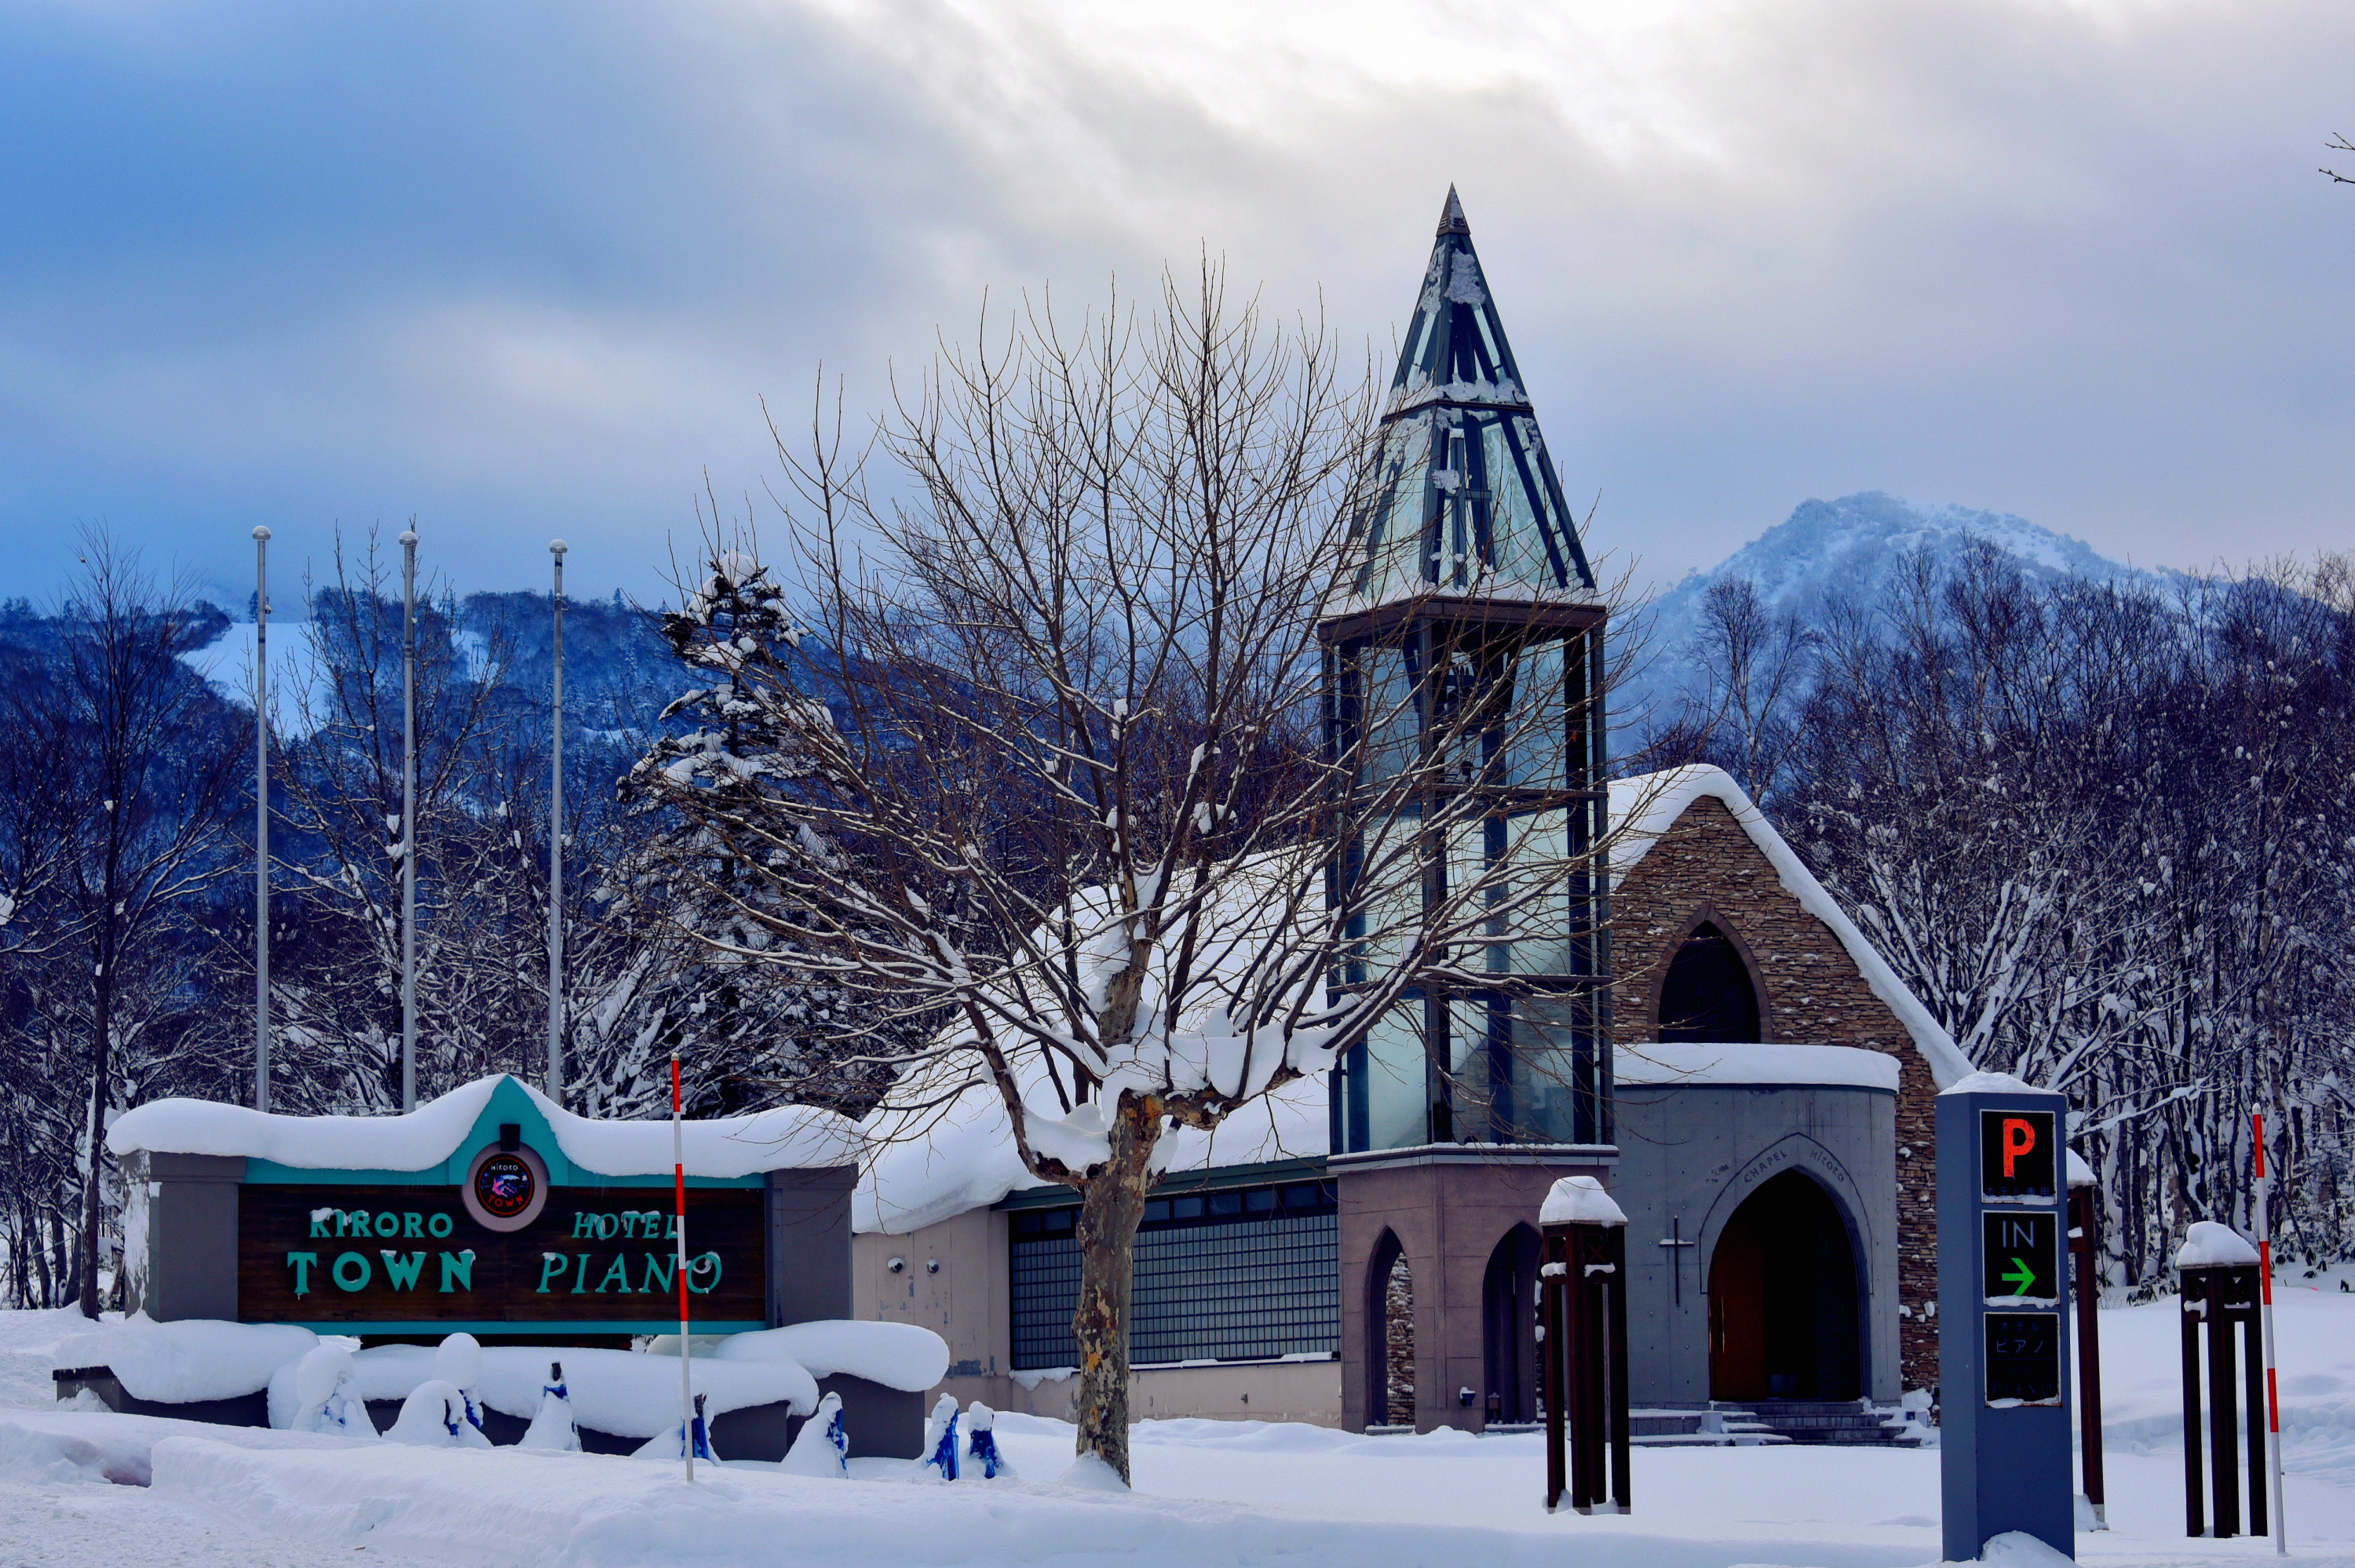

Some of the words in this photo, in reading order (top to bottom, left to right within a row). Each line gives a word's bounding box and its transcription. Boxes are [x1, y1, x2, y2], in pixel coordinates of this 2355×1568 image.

[2002, 1118, 2036, 1177] P
[1743, 1149, 1787, 1183] CHAPEL
[487, 1194, 524, 1208] TOWN
[309, 1211, 453, 1238] KIRORO
[571, 1211, 679, 1239] HOTEL
[2002, 1220, 2036, 1249] IN
[287, 1250, 474, 1294] TOWN
[535, 1252, 723, 1294] PIANO
[2000, 1321, 2041, 1332] ホテル
[1995, 1336, 2044, 1355] ピアノ
